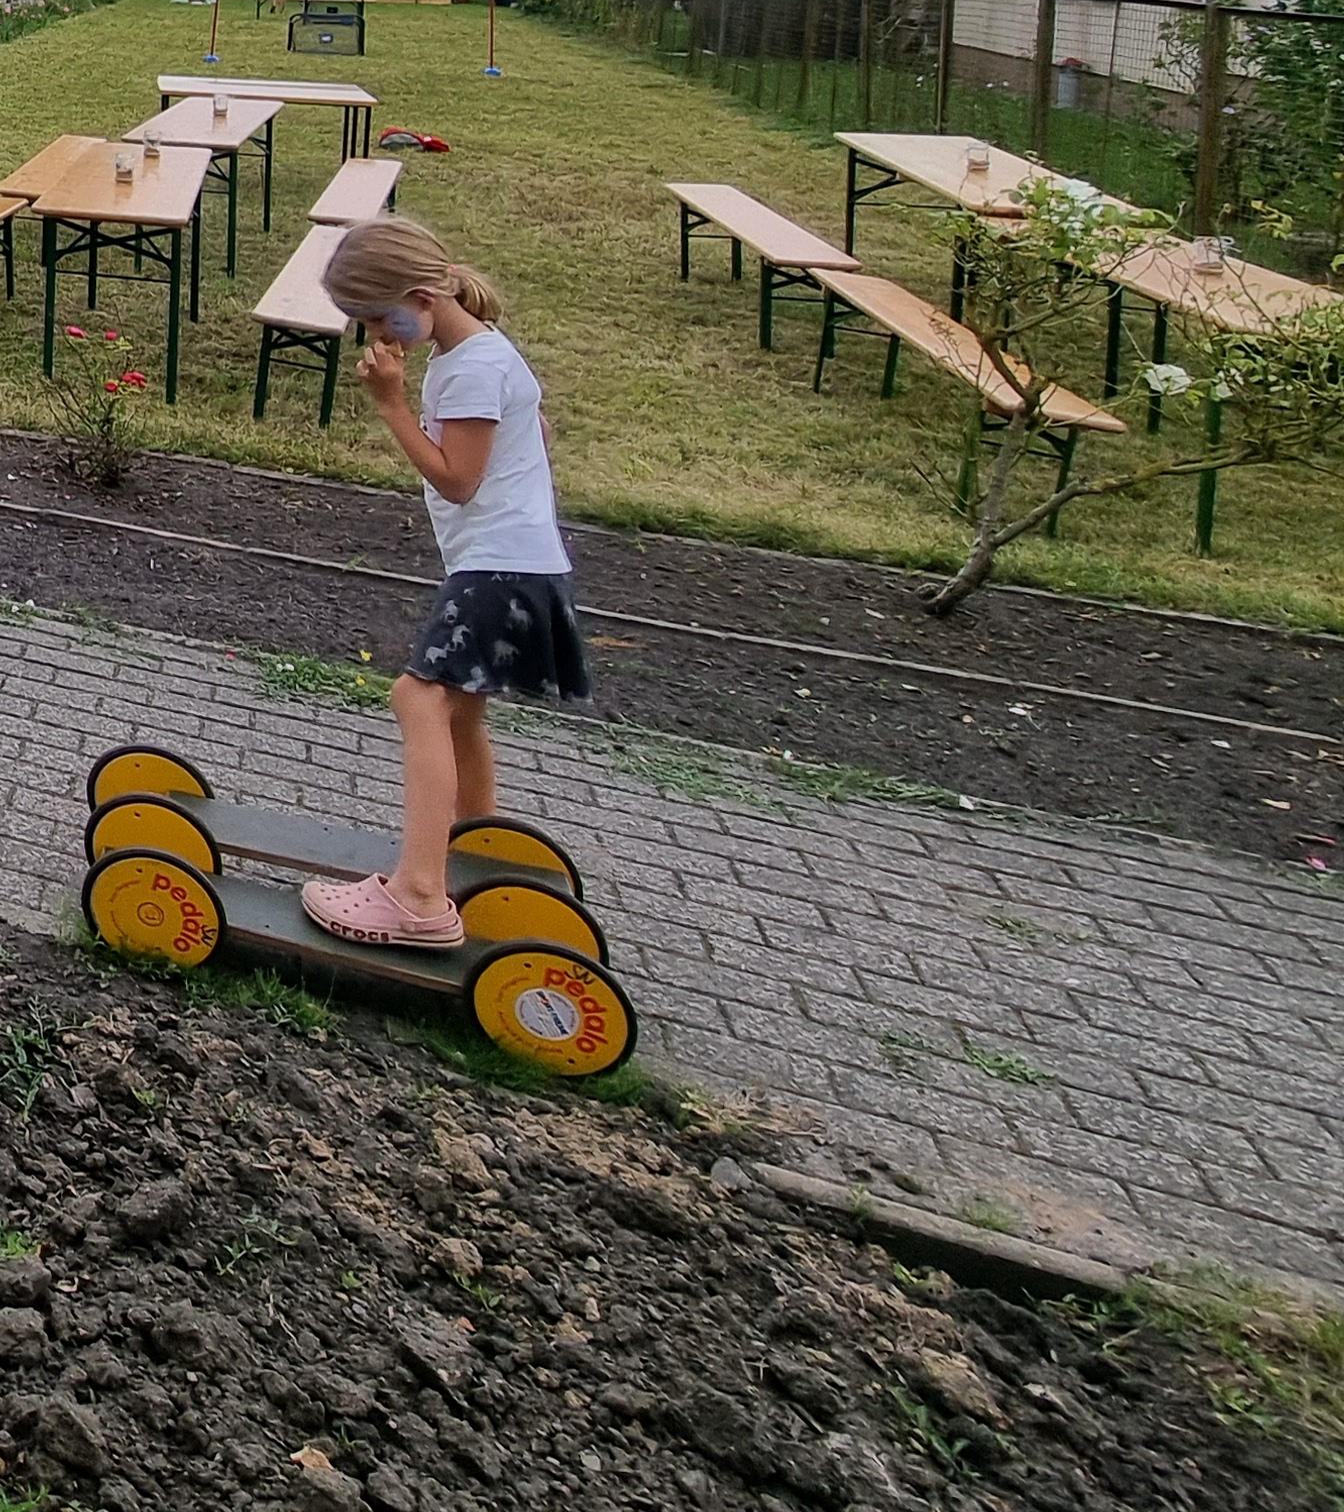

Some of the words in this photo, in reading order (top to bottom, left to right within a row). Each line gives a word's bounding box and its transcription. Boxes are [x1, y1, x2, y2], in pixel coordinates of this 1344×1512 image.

[153, 874, 204, 952] pedalo
[330, 921, 389, 942] crocs
[543, 967, 608, 1053] pedalo
